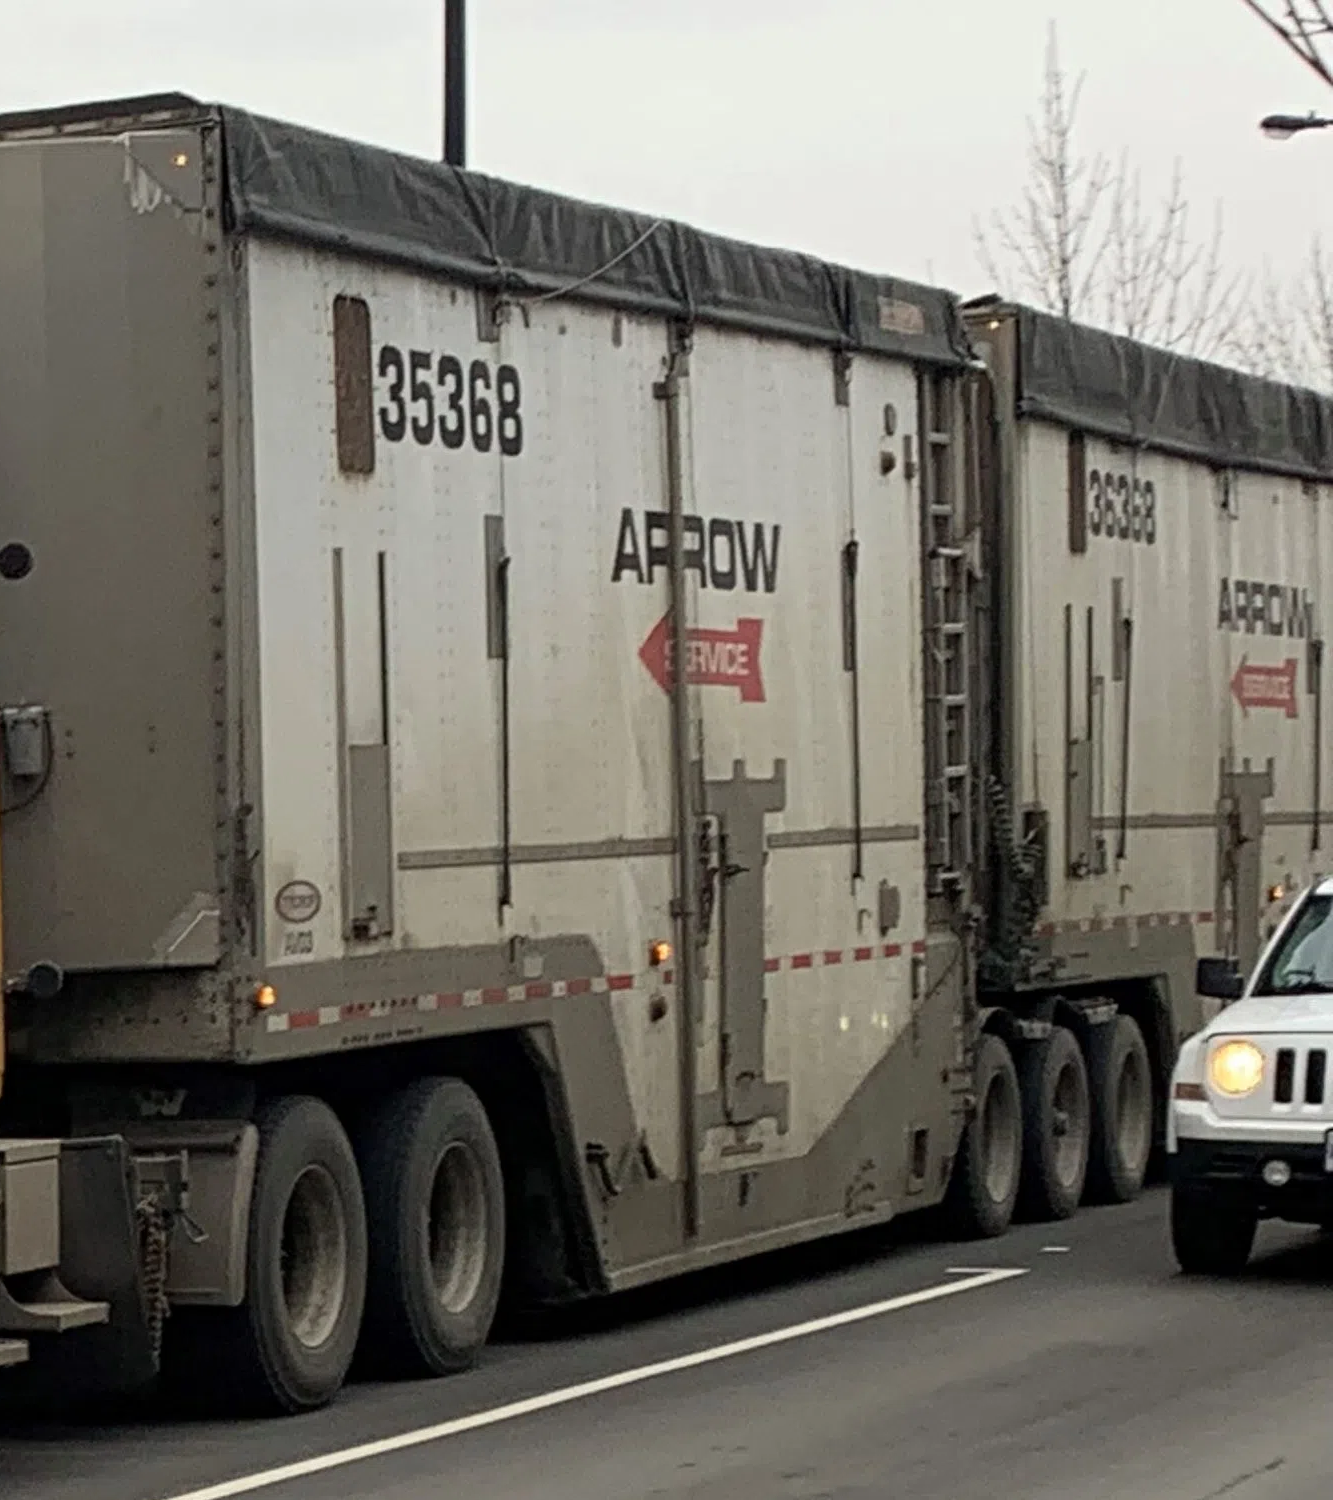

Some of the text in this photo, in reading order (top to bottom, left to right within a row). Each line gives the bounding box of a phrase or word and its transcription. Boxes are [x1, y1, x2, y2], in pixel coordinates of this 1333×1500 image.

[379, 344, 523, 457] 35368
[1090, 469, 1156, 545] 36368
[611, 507, 781, 593] ARROW
[1217, 577, 1308, 638] ARROW
